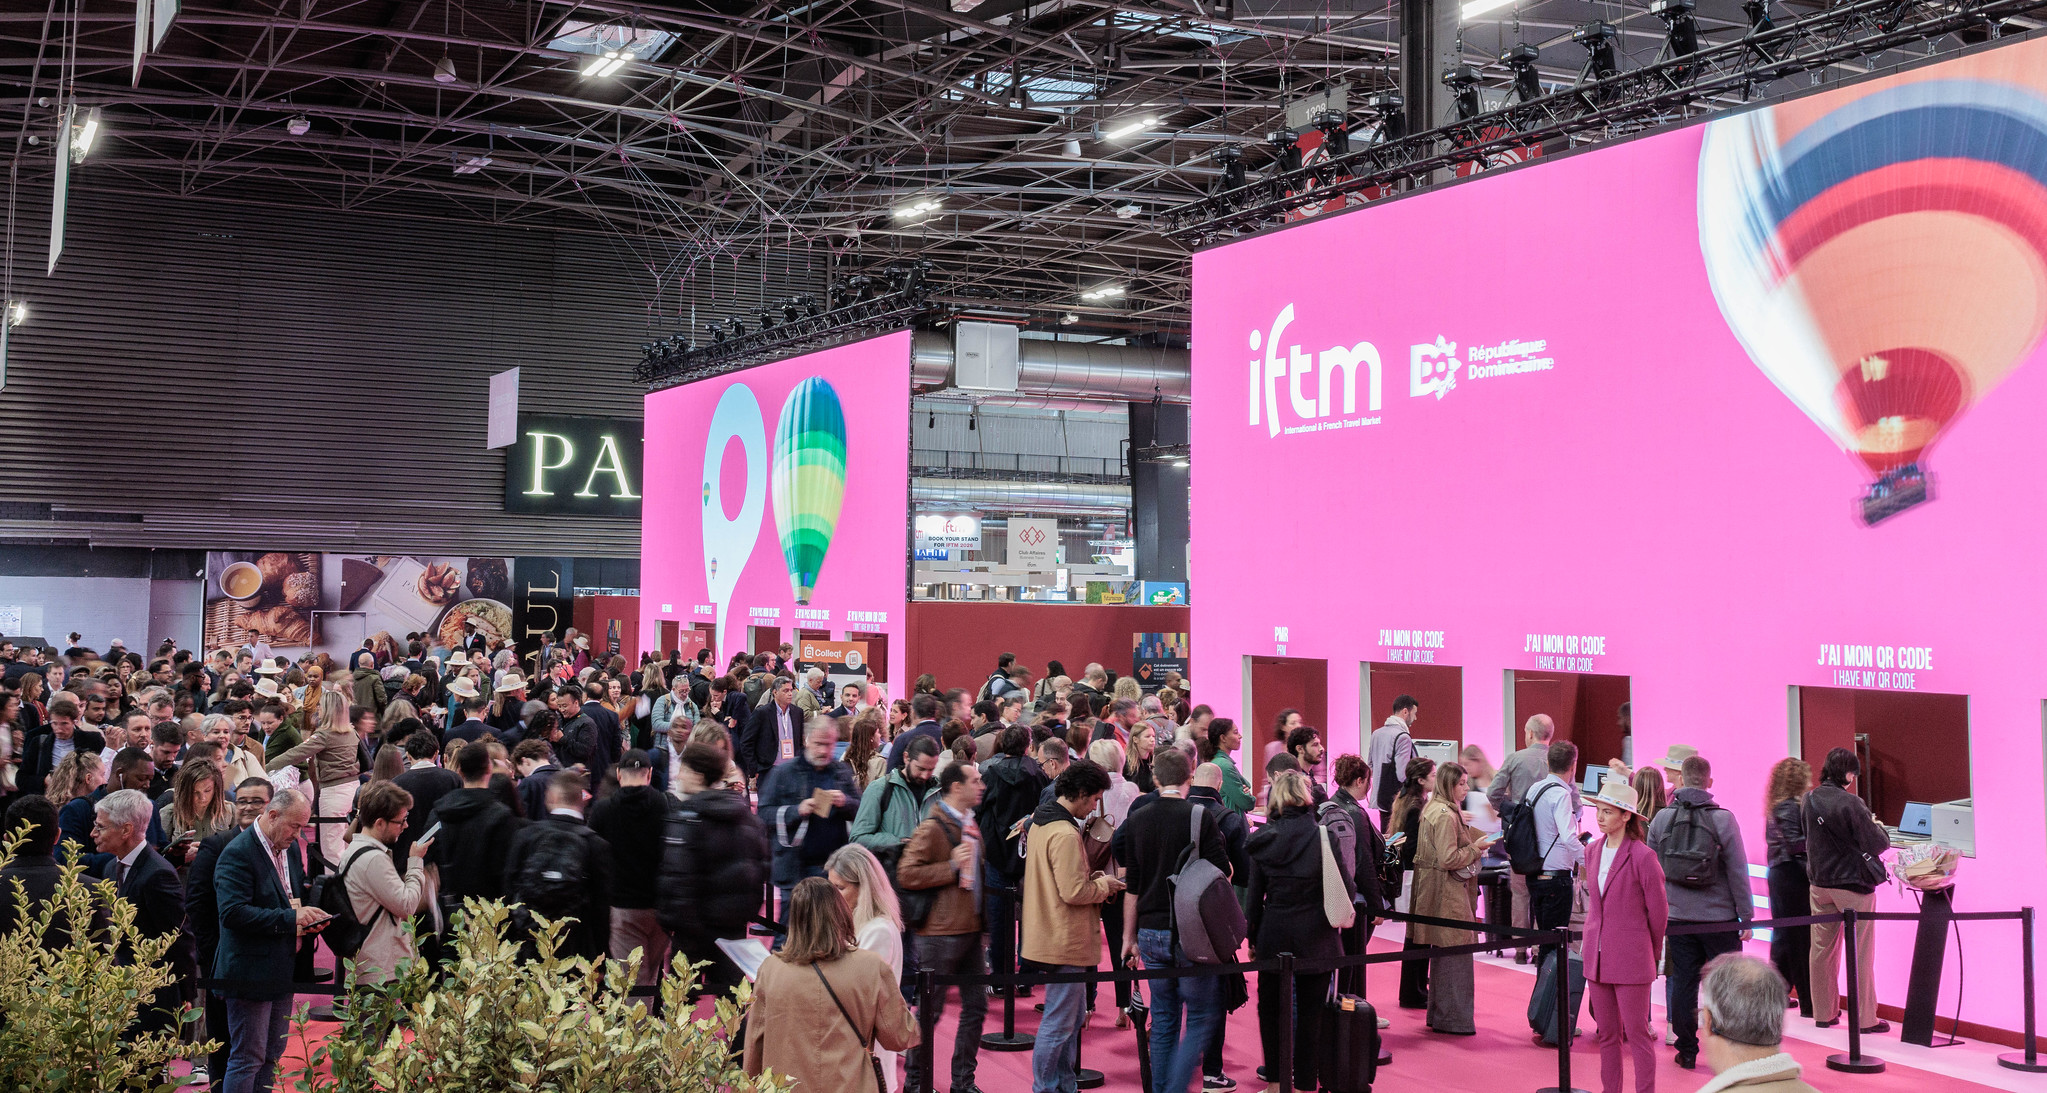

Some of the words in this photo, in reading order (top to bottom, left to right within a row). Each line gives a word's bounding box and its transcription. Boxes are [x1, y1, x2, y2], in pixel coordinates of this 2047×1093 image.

[1249, 302, 1382, 439] iftm
[1284, 423, 1317, 435] International
[1318, 422, 1322, 431] &
[1323, 420, 1342, 430] French
[1343, 418, 1360, 428] Travel
[1361, 416, 1382, 426] Market
[526, 570, 560, 661] UL
[1274, 626, 1288, 642] PMR
[1378, 629, 1392, 646] J'AI
[1393, 630, 1410, 646] MON
[1412, 630, 1422, 648] QR
[1424, 631, 1444, 648] CODE
[815, 648, 842, 659] Colleqt
[1524, 634, 1541, 652] J'AI
[1543, 634, 1563, 654] MON
[1566, 635, 1578, 655] QR
[1581, 636, 1606, 655] CODE
[1387, 649, 1390, 661] I
[1390, 649, 1403, 662] HAVE
[1404, 650, 1412, 662] MY
[1413, 650, 1420, 662] QR
[1421, 650, 1434, 663] CODE
[1535, 655, 1538, 669] I
[1539, 656, 1555, 670] HAVE
[1556, 656, 1565, 670] MY
[1566, 657, 1576, 671] QR
[1577, 657, 1594, 672] CODE
[1817, 644, 1840, 666] J'AI
[1844, 644, 1873, 667] MON
[1876, 646, 1894, 669] QR
[1898, 647, 1933, 670] CODE
[1834, 670, 1837, 685] I
[1839, 670, 1860, 686] HAVE
[1862, 671, 1876, 688] MY
[1878, 672, 1890, 689] QR
[1892, 672, 1916, 690] CODE
